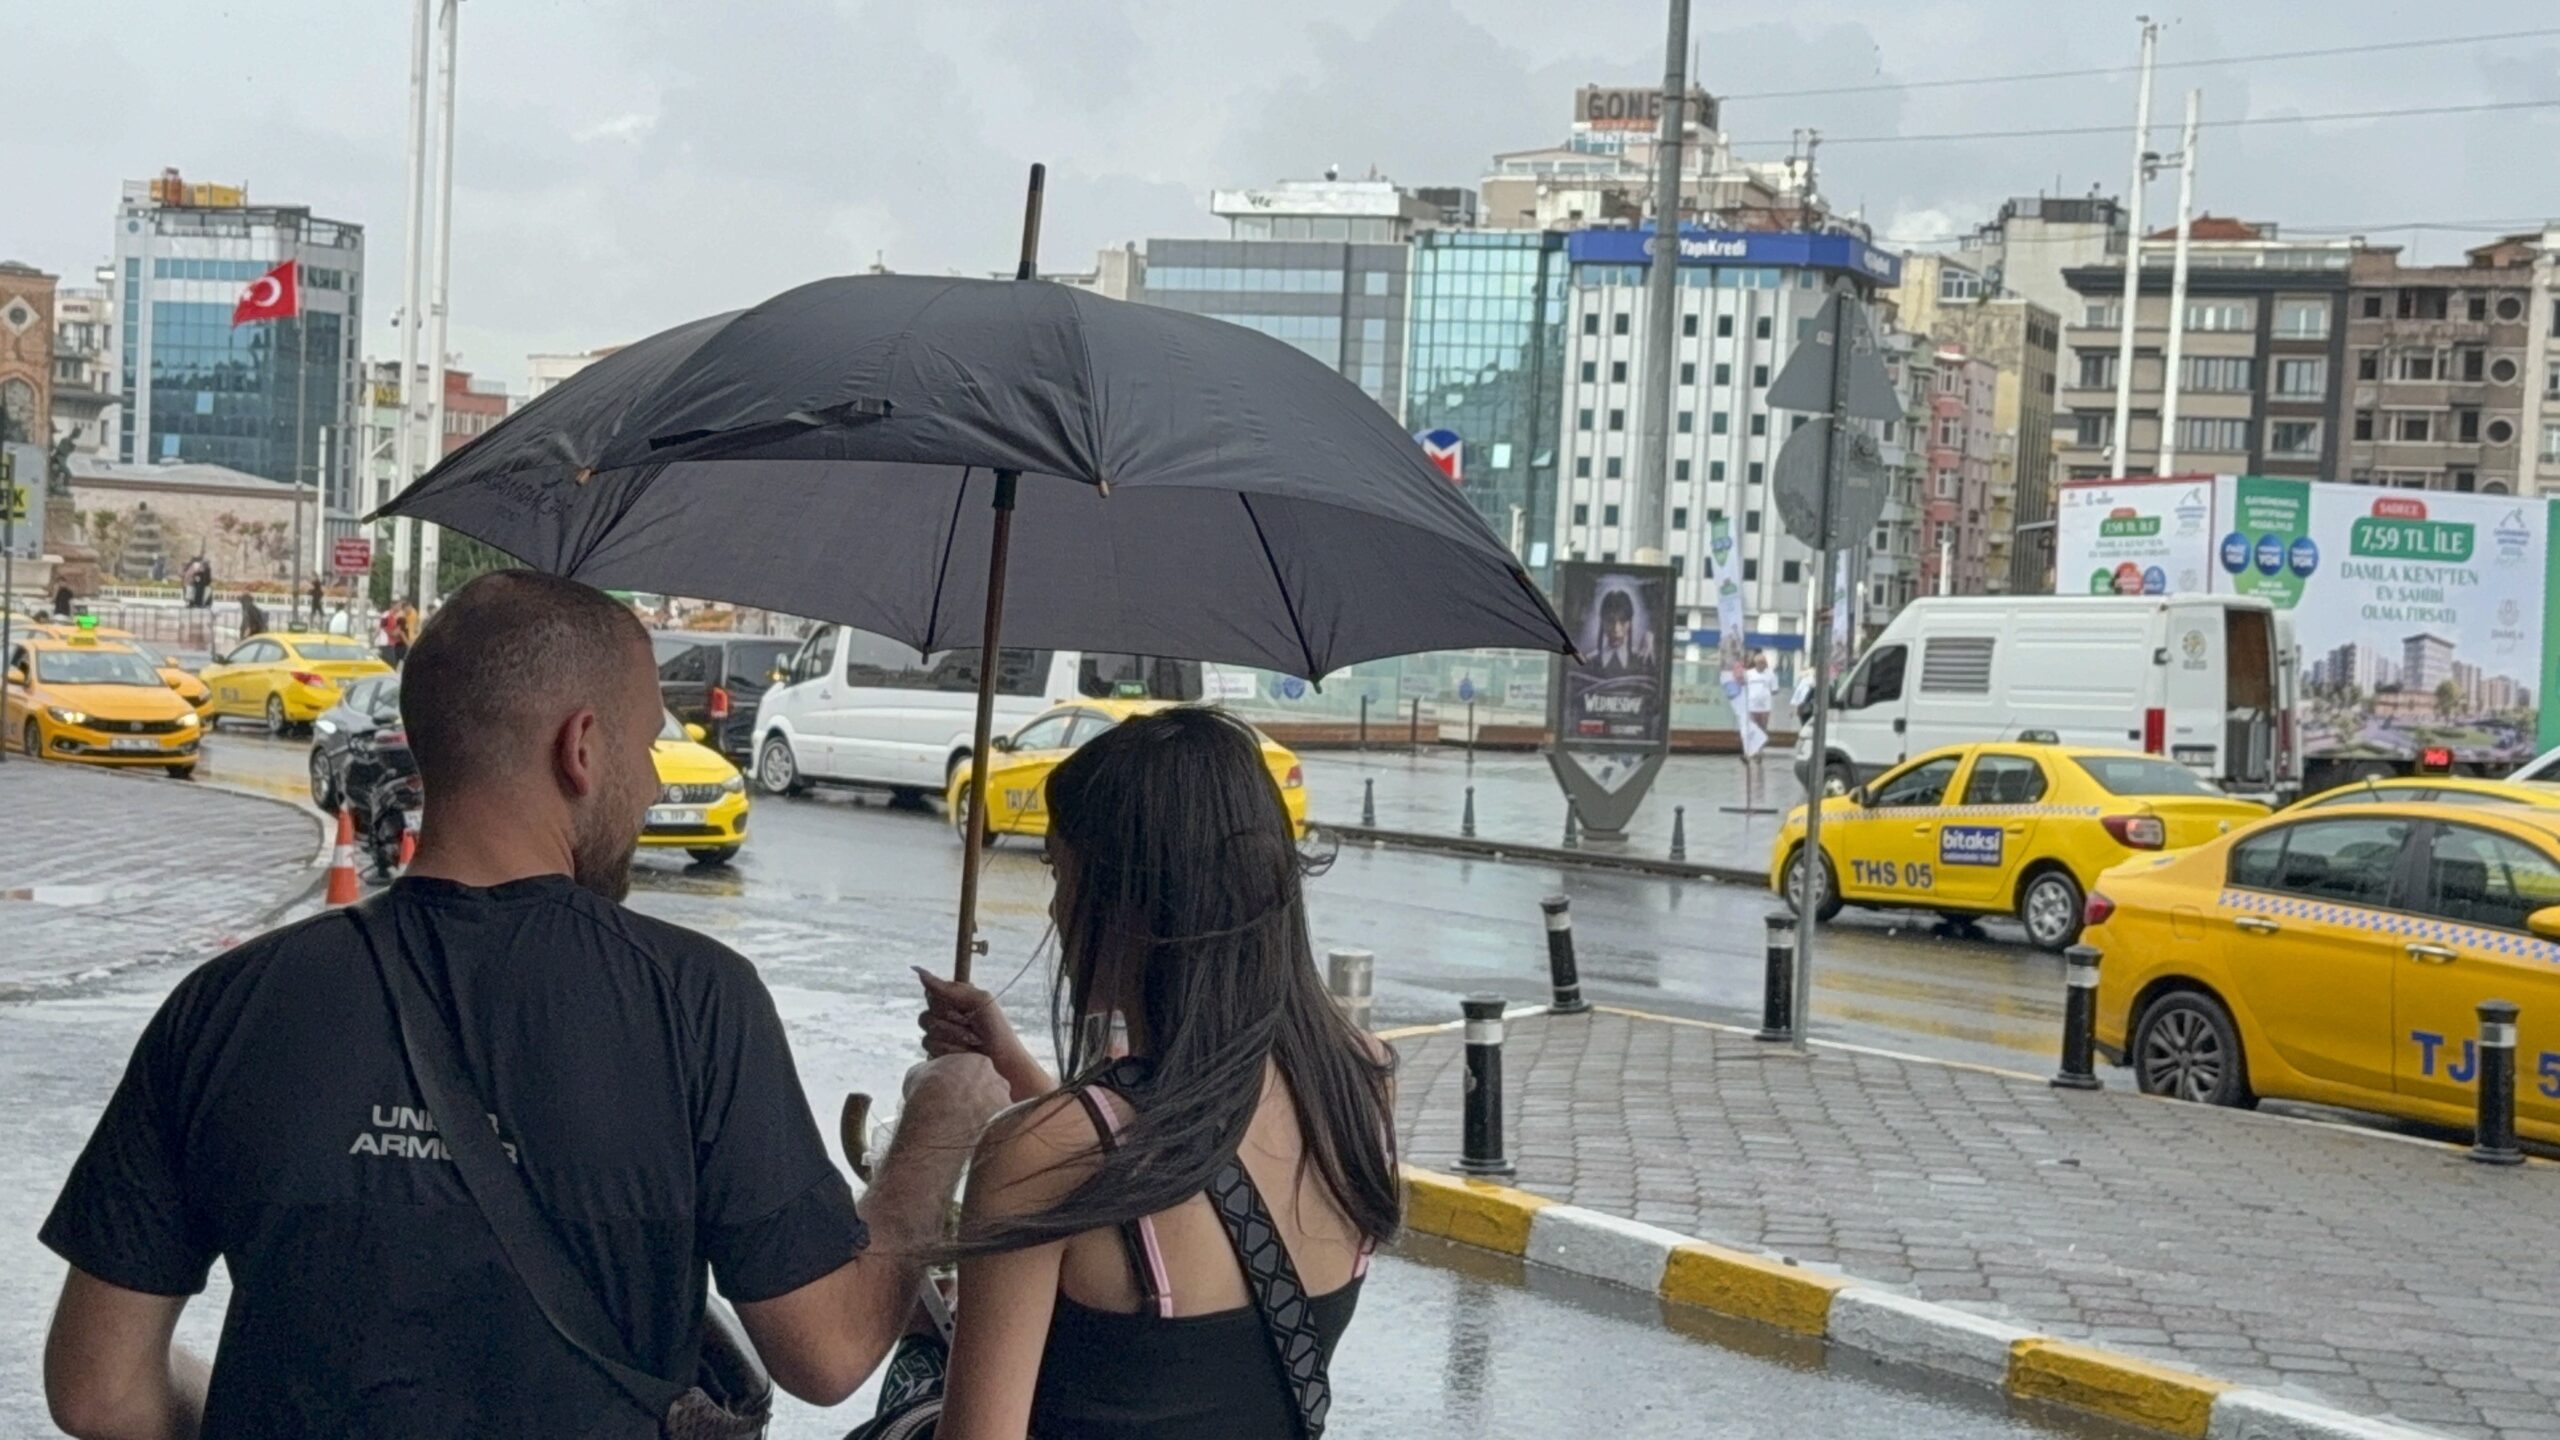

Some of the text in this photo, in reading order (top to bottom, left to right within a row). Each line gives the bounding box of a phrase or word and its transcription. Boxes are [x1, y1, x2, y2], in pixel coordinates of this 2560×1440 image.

[2360, 525, 2400, 552] 7,59
[2404, 528, 2430, 553] TL
[2433, 525, 2465, 554] İLE
[2340, 562, 2399, 582] DAMLA
[2376, 586, 2444, 603] EV SAHİBİ
[2361, 604, 2457, 624] OLMA FIRSATI
[1584, 693, 1644, 714] WEDNESDAY
[1943, 829, 2001, 851] bitaksi
[1851, 859, 1933, 889] THS 05
